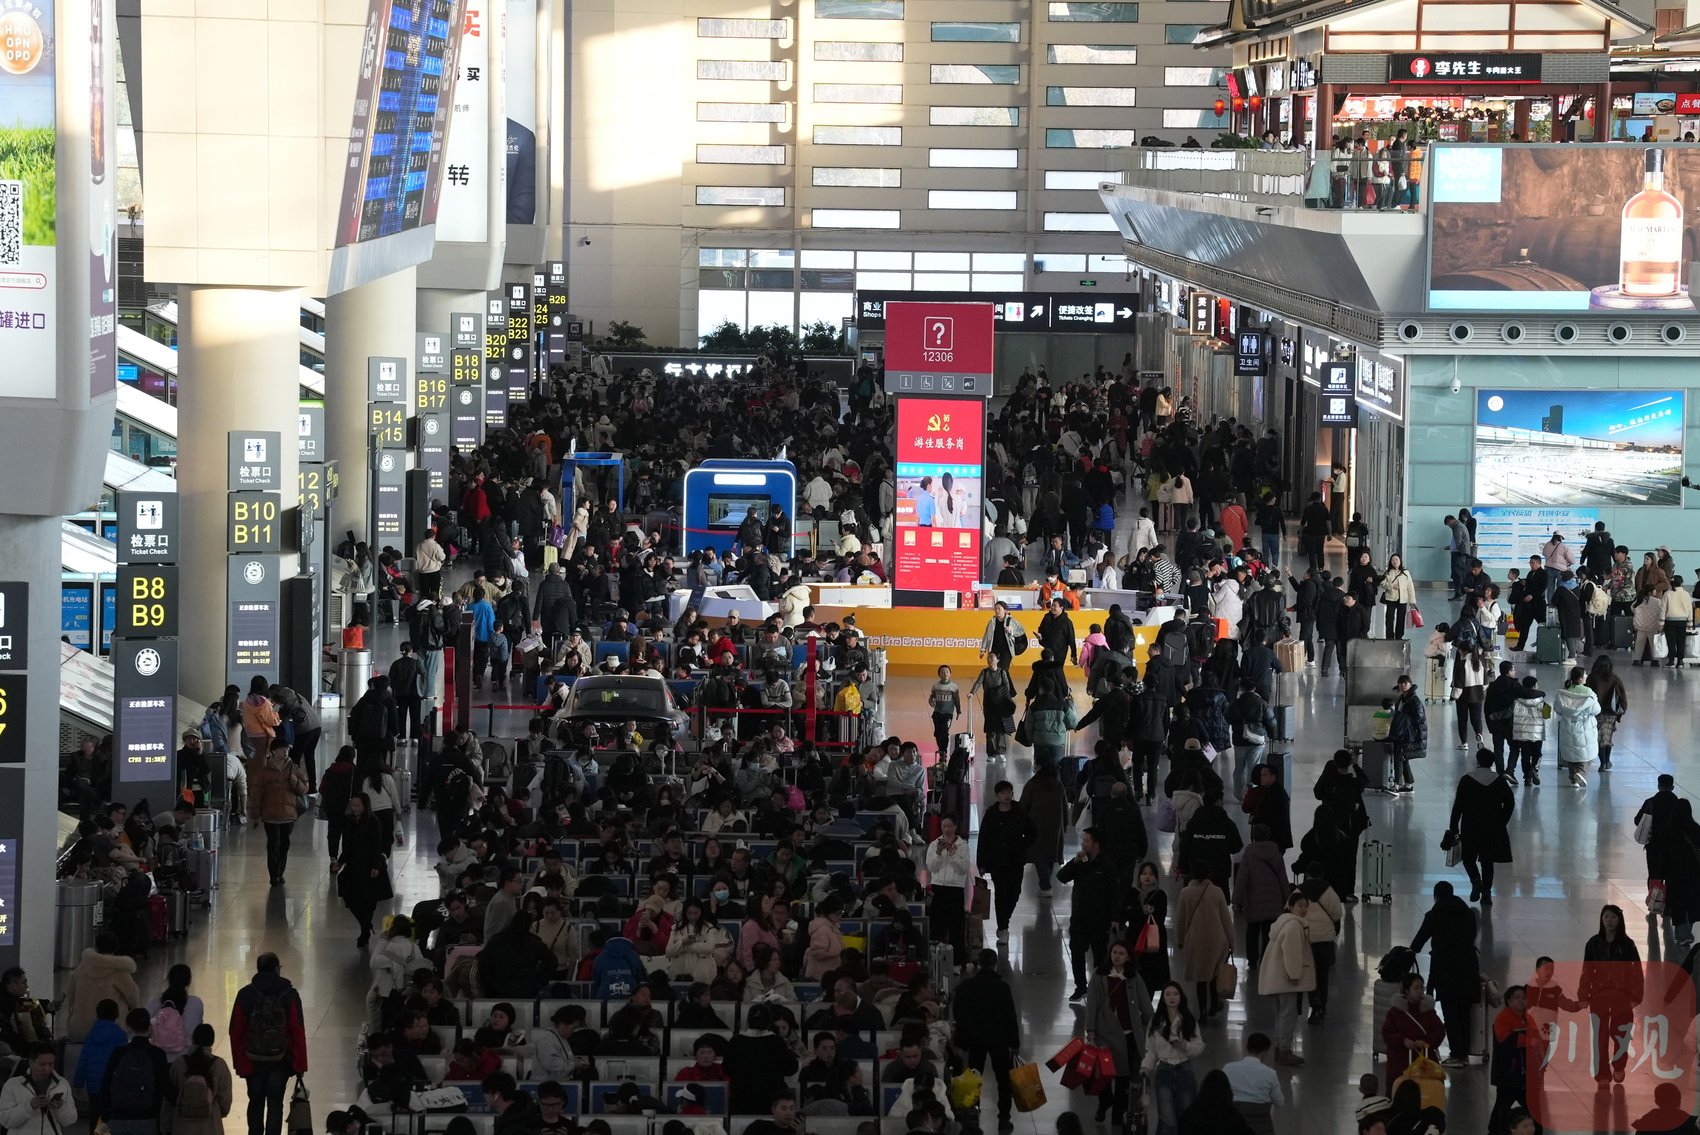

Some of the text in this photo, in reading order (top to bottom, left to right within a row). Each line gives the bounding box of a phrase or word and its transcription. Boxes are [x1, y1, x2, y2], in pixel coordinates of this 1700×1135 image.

[6, 37, 30, 48] OPN
[6, 50, 30, 61] OPO
[1435, 61, 1481, 75] 李先生
[448, 164, 470, 186] 转
[549, 296, 566, 304] B26
[862, 301, 882, 311] 商业
[1058, 305, 1094, 314] 便捷改签
[508, 318, 528, 328] B22
[508, 329, 528, 339] B23
[486, 335, 506, 345] B20
[486, 347, 506, 358] B21
[923, 352, 953, 362] 12306
[455, 355, 479, 366] B18
[455, 369, 479, 380] B19
[377, 383, 400, 392] 检票口
[418, 380, 446, 392] B16
[418, 395, 446, 408] B17
[373, 410, 402, 424] B14
[240, 466, 271, 477] 检票口
[234, 502, 275, 520] B10
[234, 524, 271, 544] B11
[131, 534, 169, 547] 检票口
[133, 577, 165, 599] B8
[132, 604, 165, 627] B9
